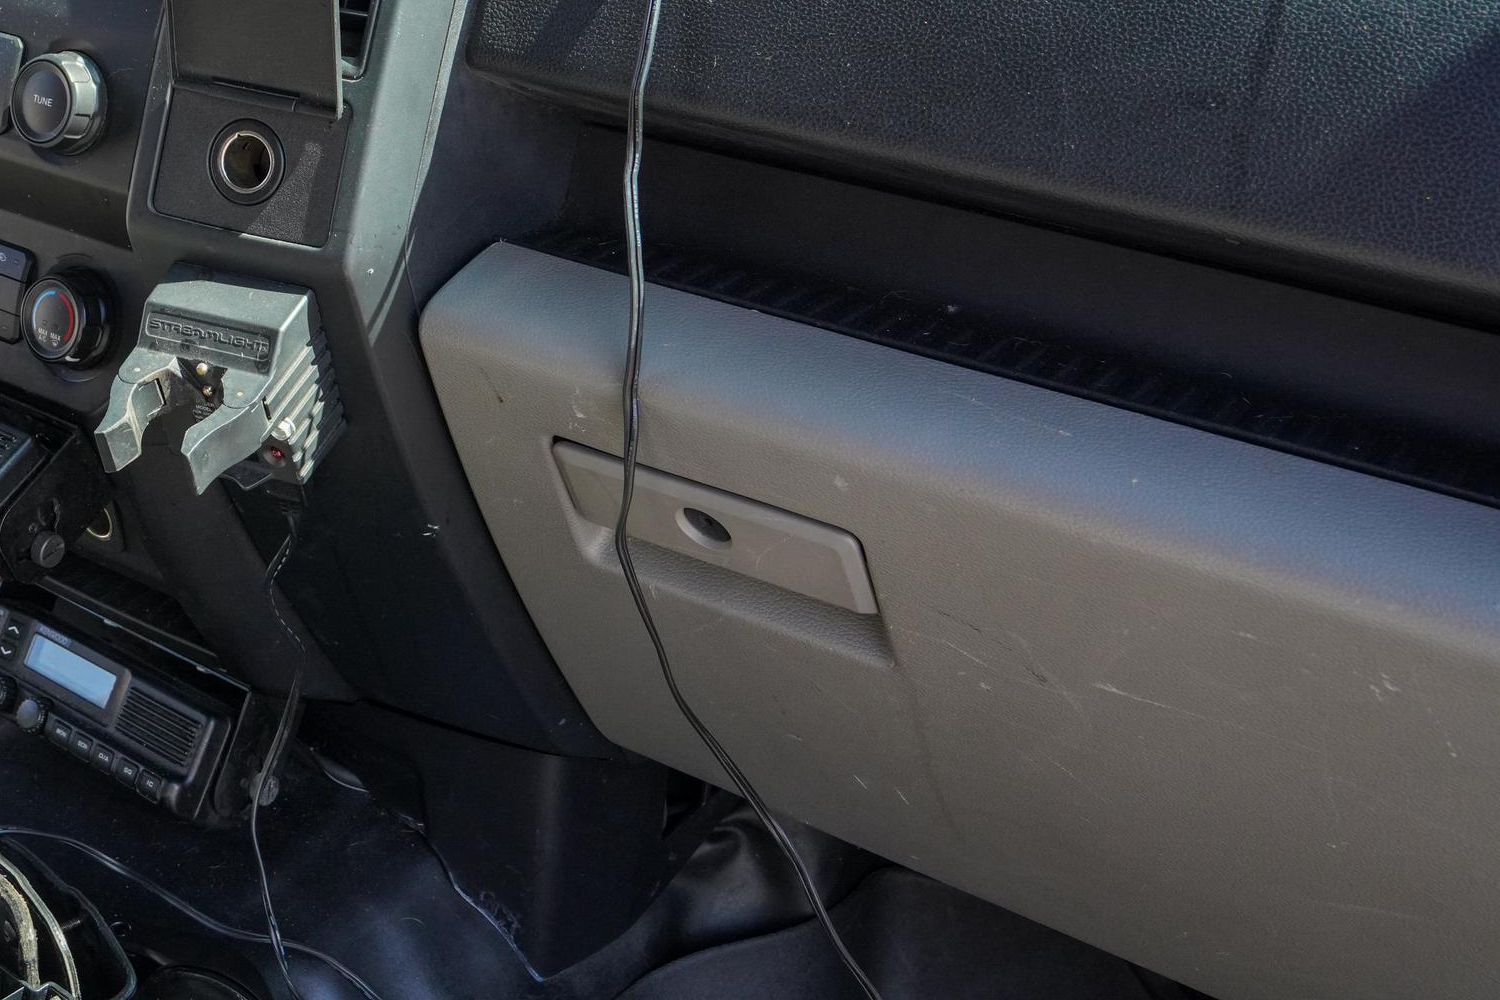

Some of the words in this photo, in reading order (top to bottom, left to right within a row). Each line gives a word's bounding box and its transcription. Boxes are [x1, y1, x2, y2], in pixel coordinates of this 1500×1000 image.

[33, 94, 53, 107] TUNE
[149, 318, 269, 353] STREAMLIGHT
[39, 624, 70, 645] KENWOOD
